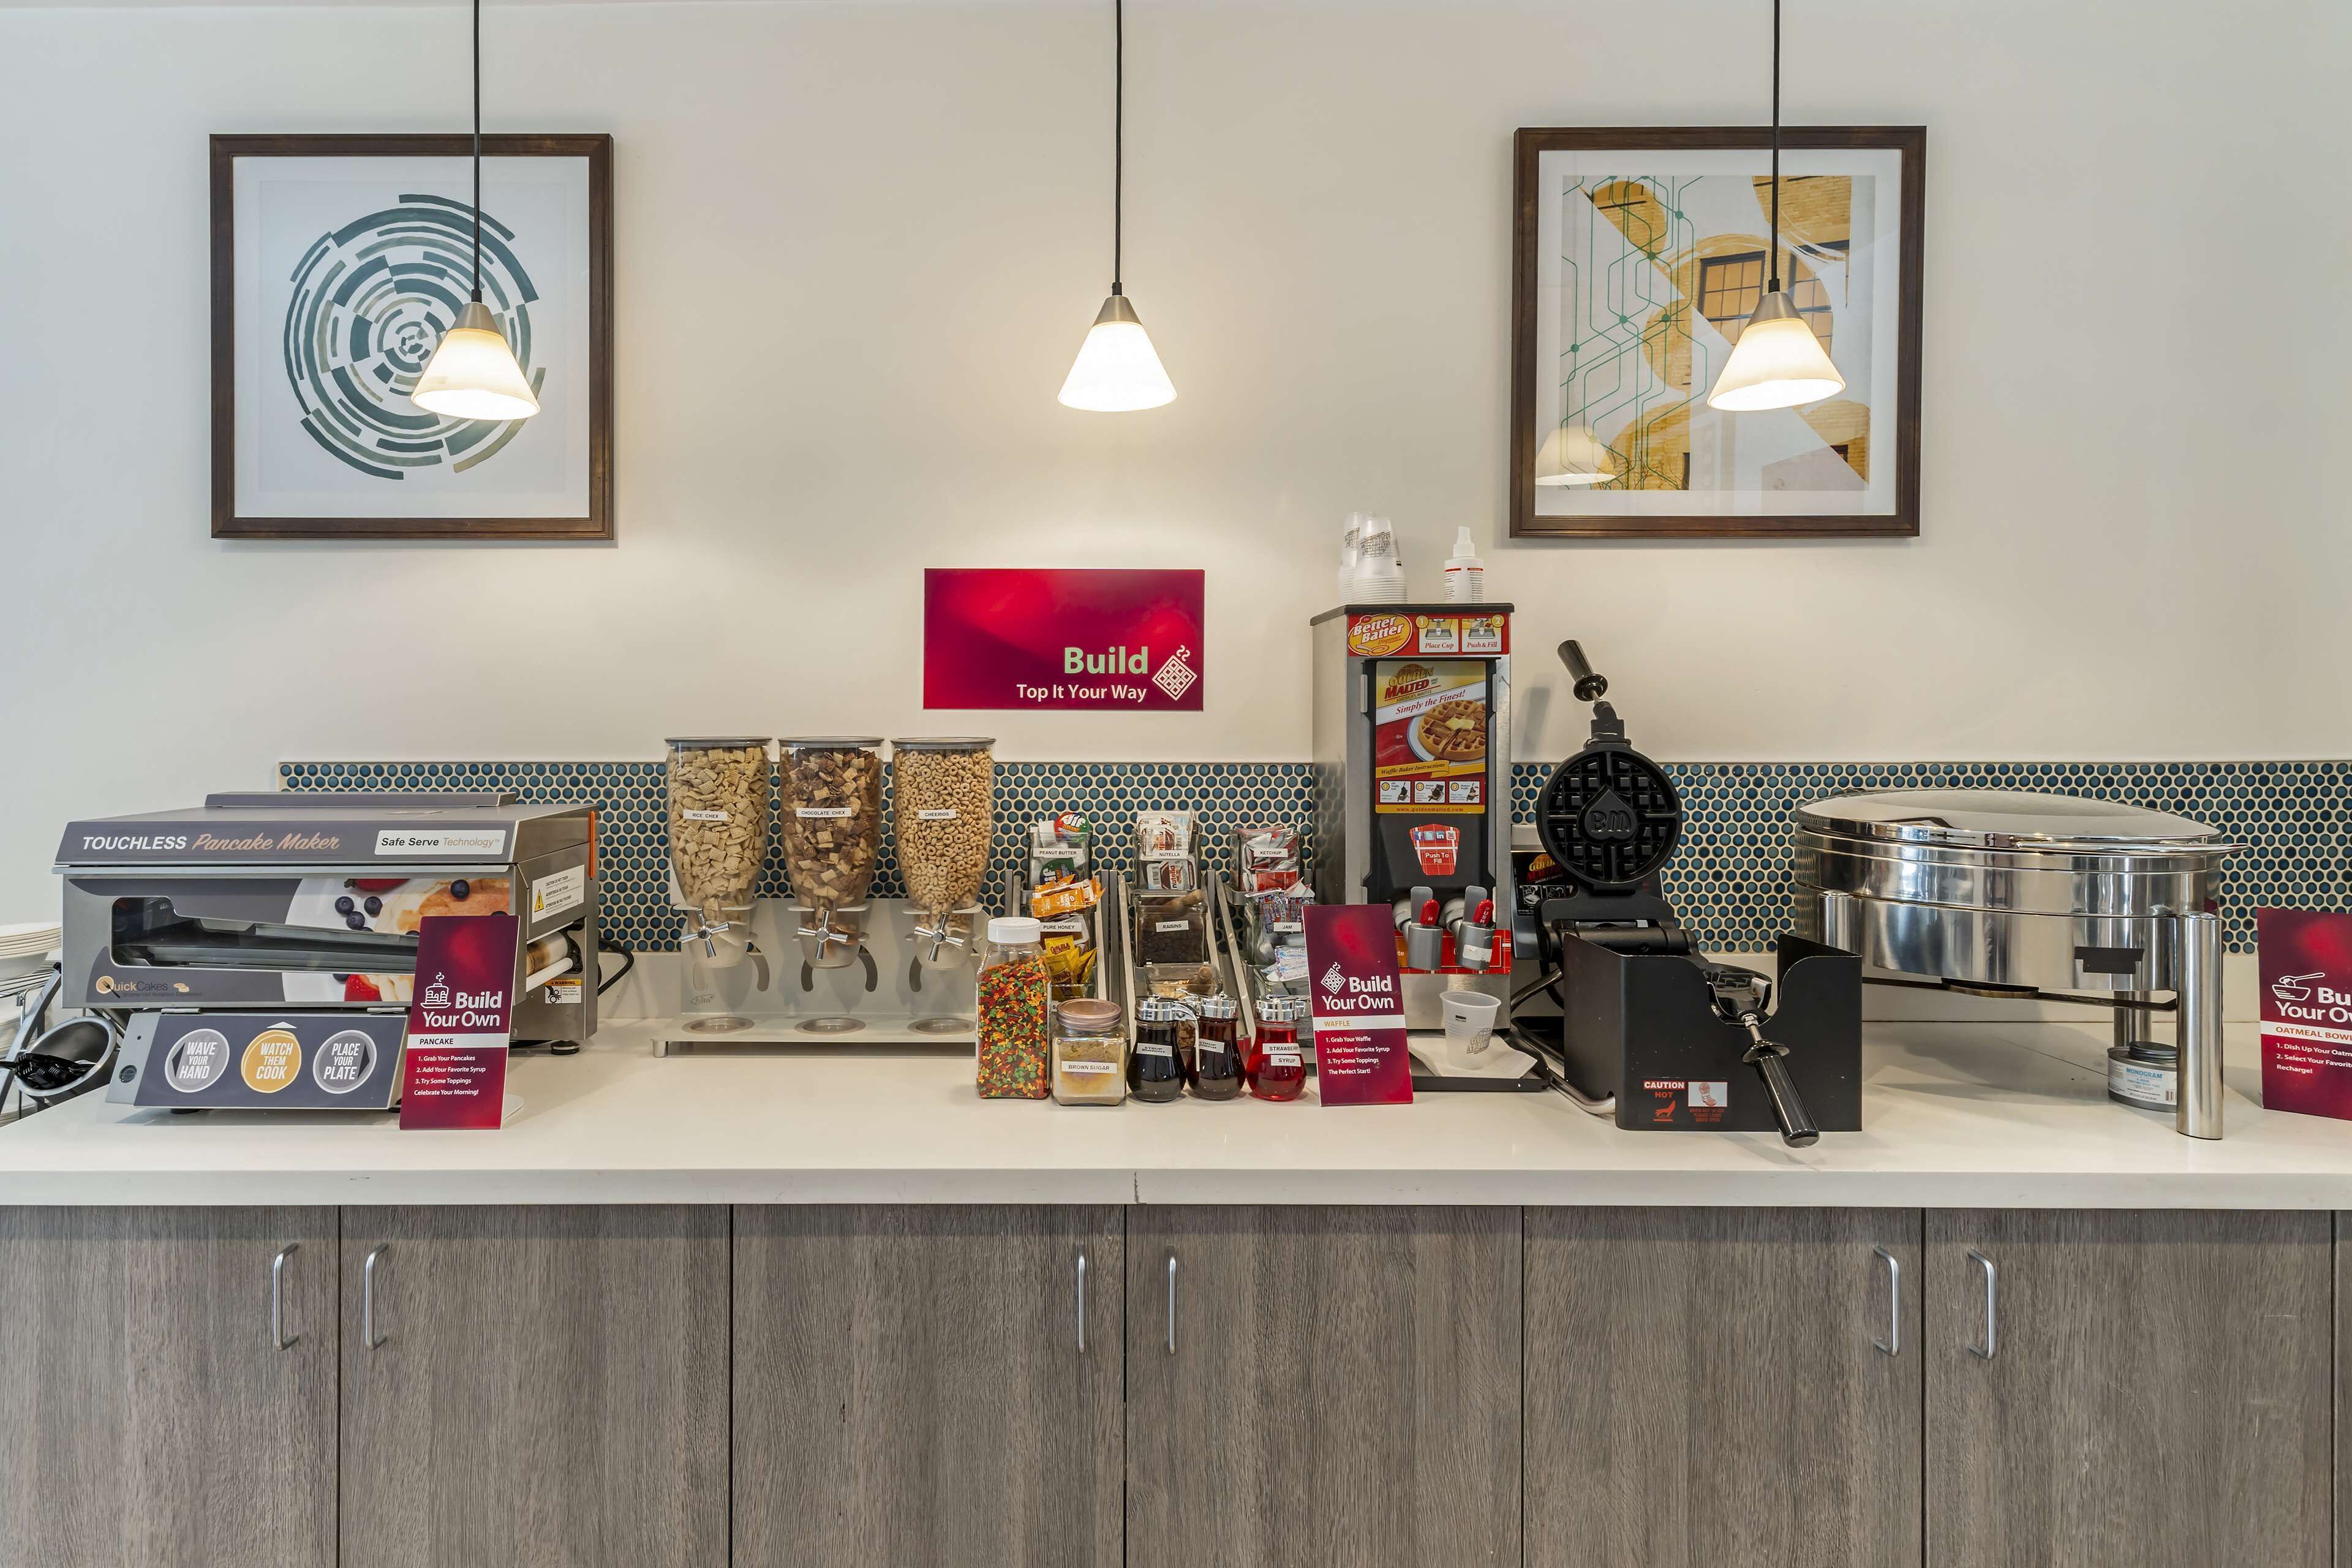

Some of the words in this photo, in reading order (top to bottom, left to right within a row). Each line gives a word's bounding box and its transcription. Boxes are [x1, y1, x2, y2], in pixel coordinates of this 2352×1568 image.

[1353, 616, 1396, 636] Better
[1361, 624, 1404, 643] Batter
[1065, 646, 1148, 673] Build
[1017, 684, 1048, 702] Top
[1053, 684, 1063, 698] It
[1068, 685, 1107, 698] Your
[1111, 685, 1147, 703] Way
[1385, 679, 1430, 699] MALTED
[1396, 702, 1423, 715] Simply
[1425, 698, 1438, 707] the
[1439, 690, 1466, 703] Finest!
[83, 836, 187, 850] TOUCHLESS
[192, 833, 273, 851] Pancake
[276, 832, 340, 850] Maker
[382, 837, 405, 846] Safe
[409, 837, 439, 846] Serve
[1349, 976, 1392, 992] Build
[455, 991, 502, 1009] Build
[1322, 995, 1356, 1010] Your
[1358, 994, 1394, 1009] Own
[2275, 1001, 2326, 1020] Your
[423, 1011, 459, 1027] Your
[461, 1011, 500, 1027] Own
[2276, 1027, 2323, 1038] OATMEAL
[186, 1042, 217, 1056] WAVE
[260, 1043, 293, 1056] WATCH
[331, 1043, 360, 1056] PLACE
[189, 1056, 208, 1065] YOUR
[263, 1057, 286, 1065] THEM
[334, 1057, 353, 1066] YOUR
[179, 1066, 210, 1079] HAND
[256, 1066, 288, 1079] COOK
[323, 1066, 357, 1080] PLATE
[2127, 1068, 2162, 1078] MONOGRAM
[2277, 1065, 2313, 1074] Recharge!
